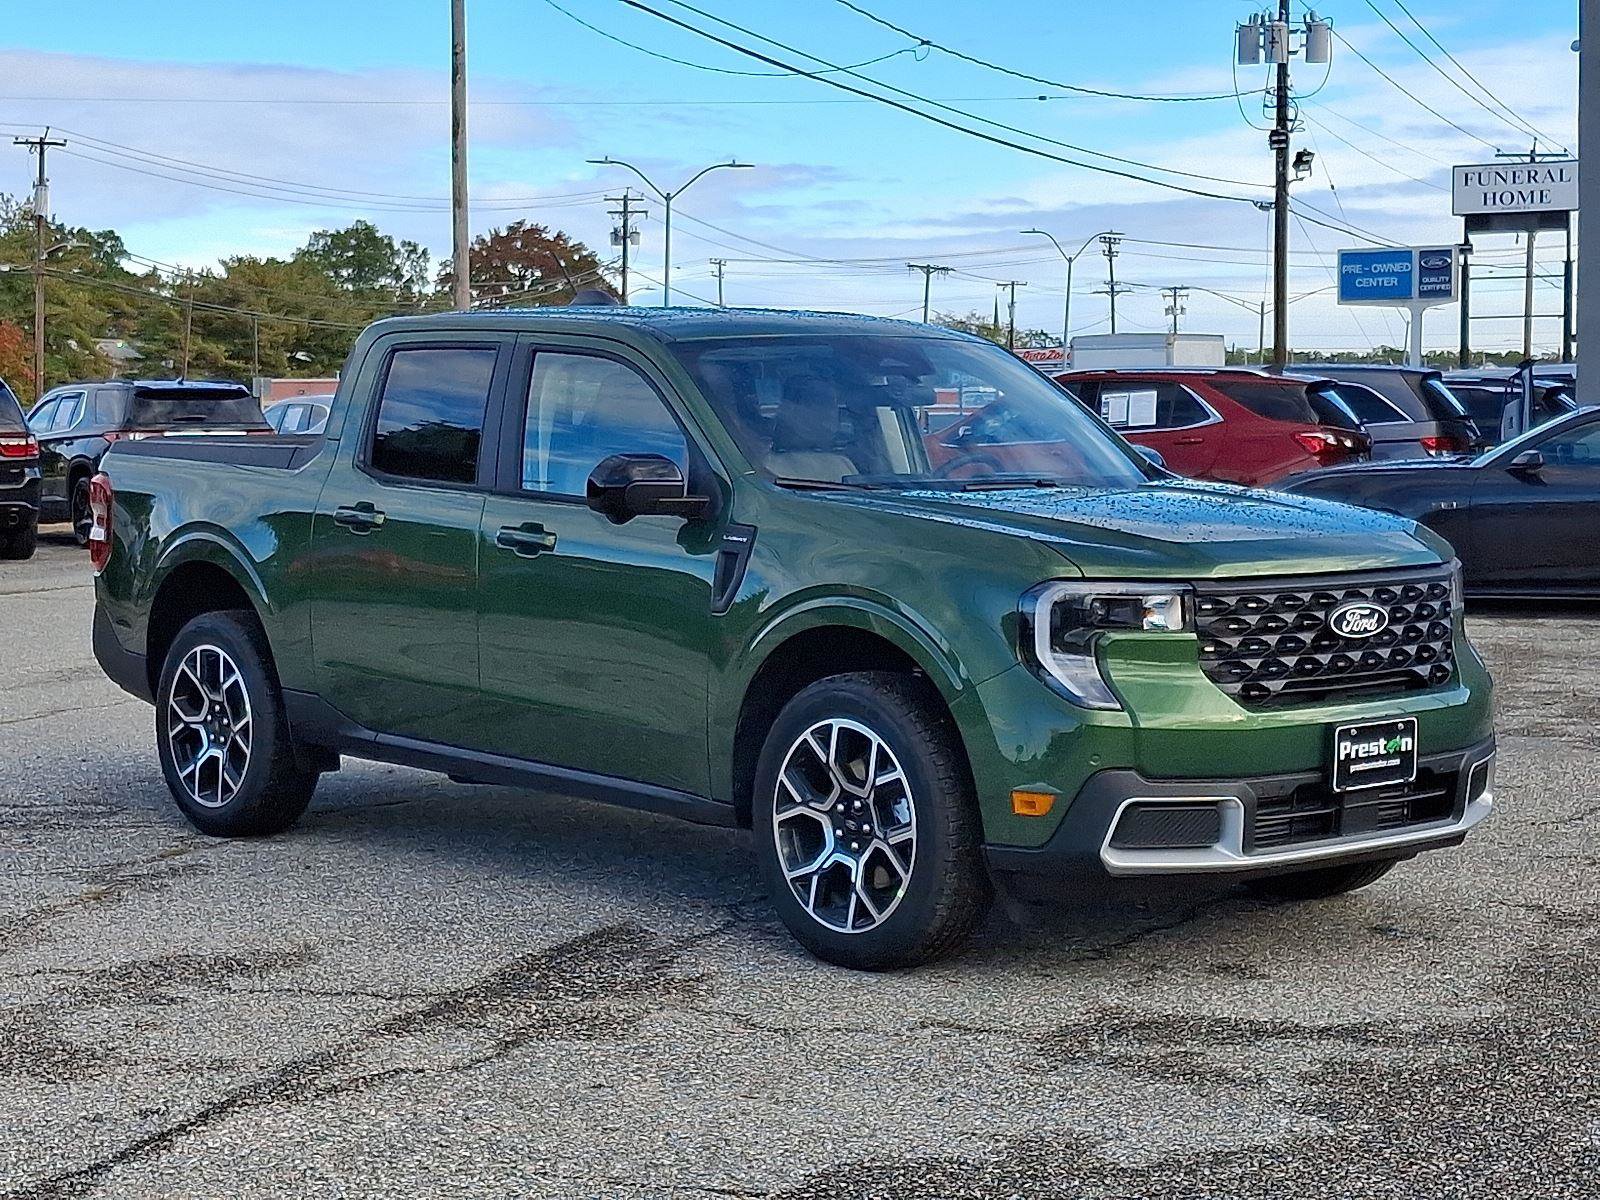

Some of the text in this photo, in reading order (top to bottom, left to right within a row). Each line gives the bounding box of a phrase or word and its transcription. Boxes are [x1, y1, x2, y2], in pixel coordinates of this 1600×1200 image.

[1464, 168, 1571, 187] FUNERAL
[1483, 190, 1552, 206] HOME
[1355, 277, 1398, 287] CENTER
[1341, 609, 1378, 632] Ford
